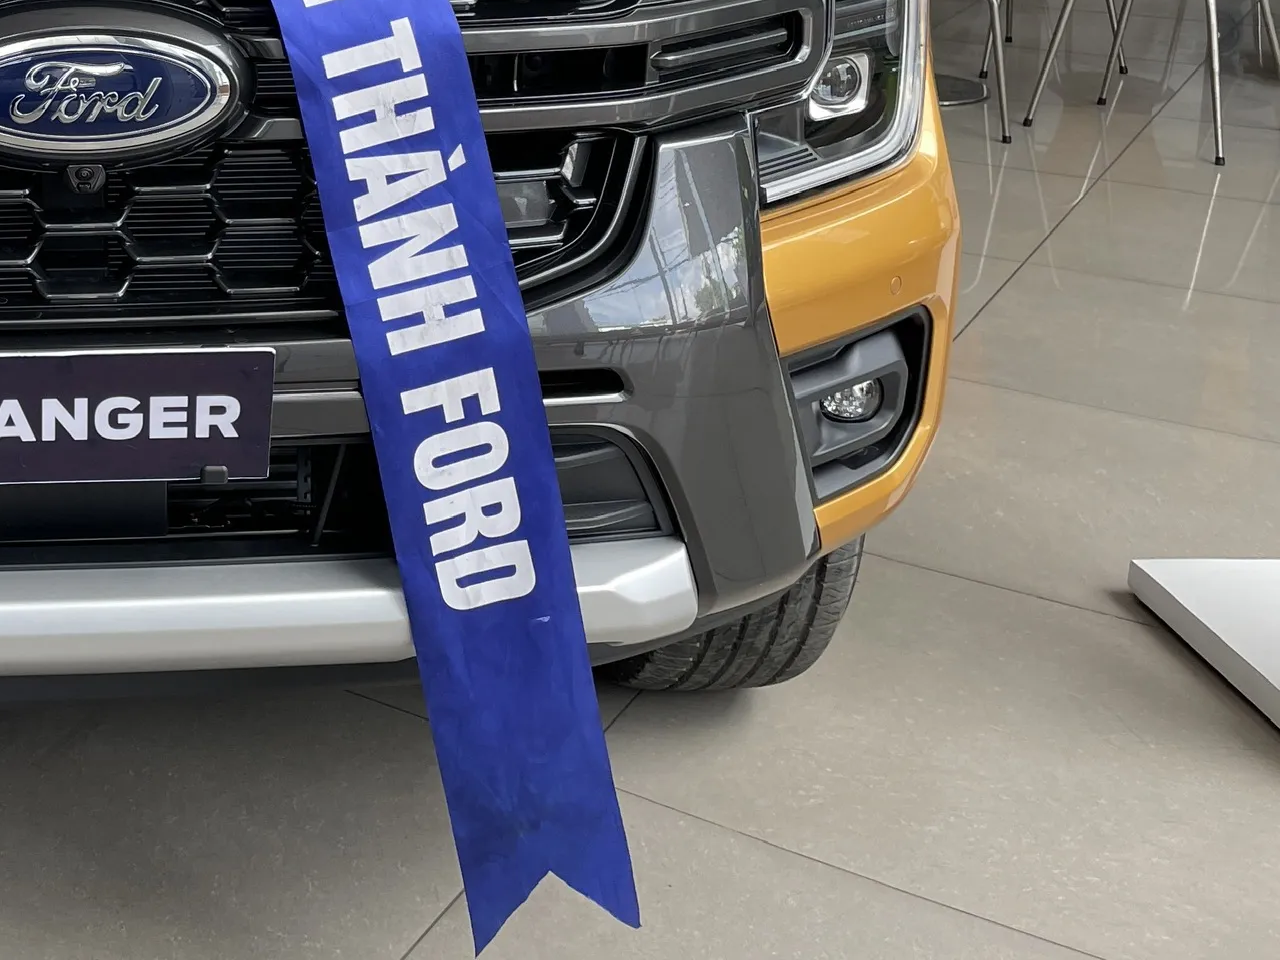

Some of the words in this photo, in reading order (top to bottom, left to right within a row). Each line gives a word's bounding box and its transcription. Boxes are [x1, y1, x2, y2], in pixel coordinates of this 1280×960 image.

[10, 59, 163, 125] Ford
[322, 16, 486, 356] THÀNH
[400, 367, 537, 611] FORD
